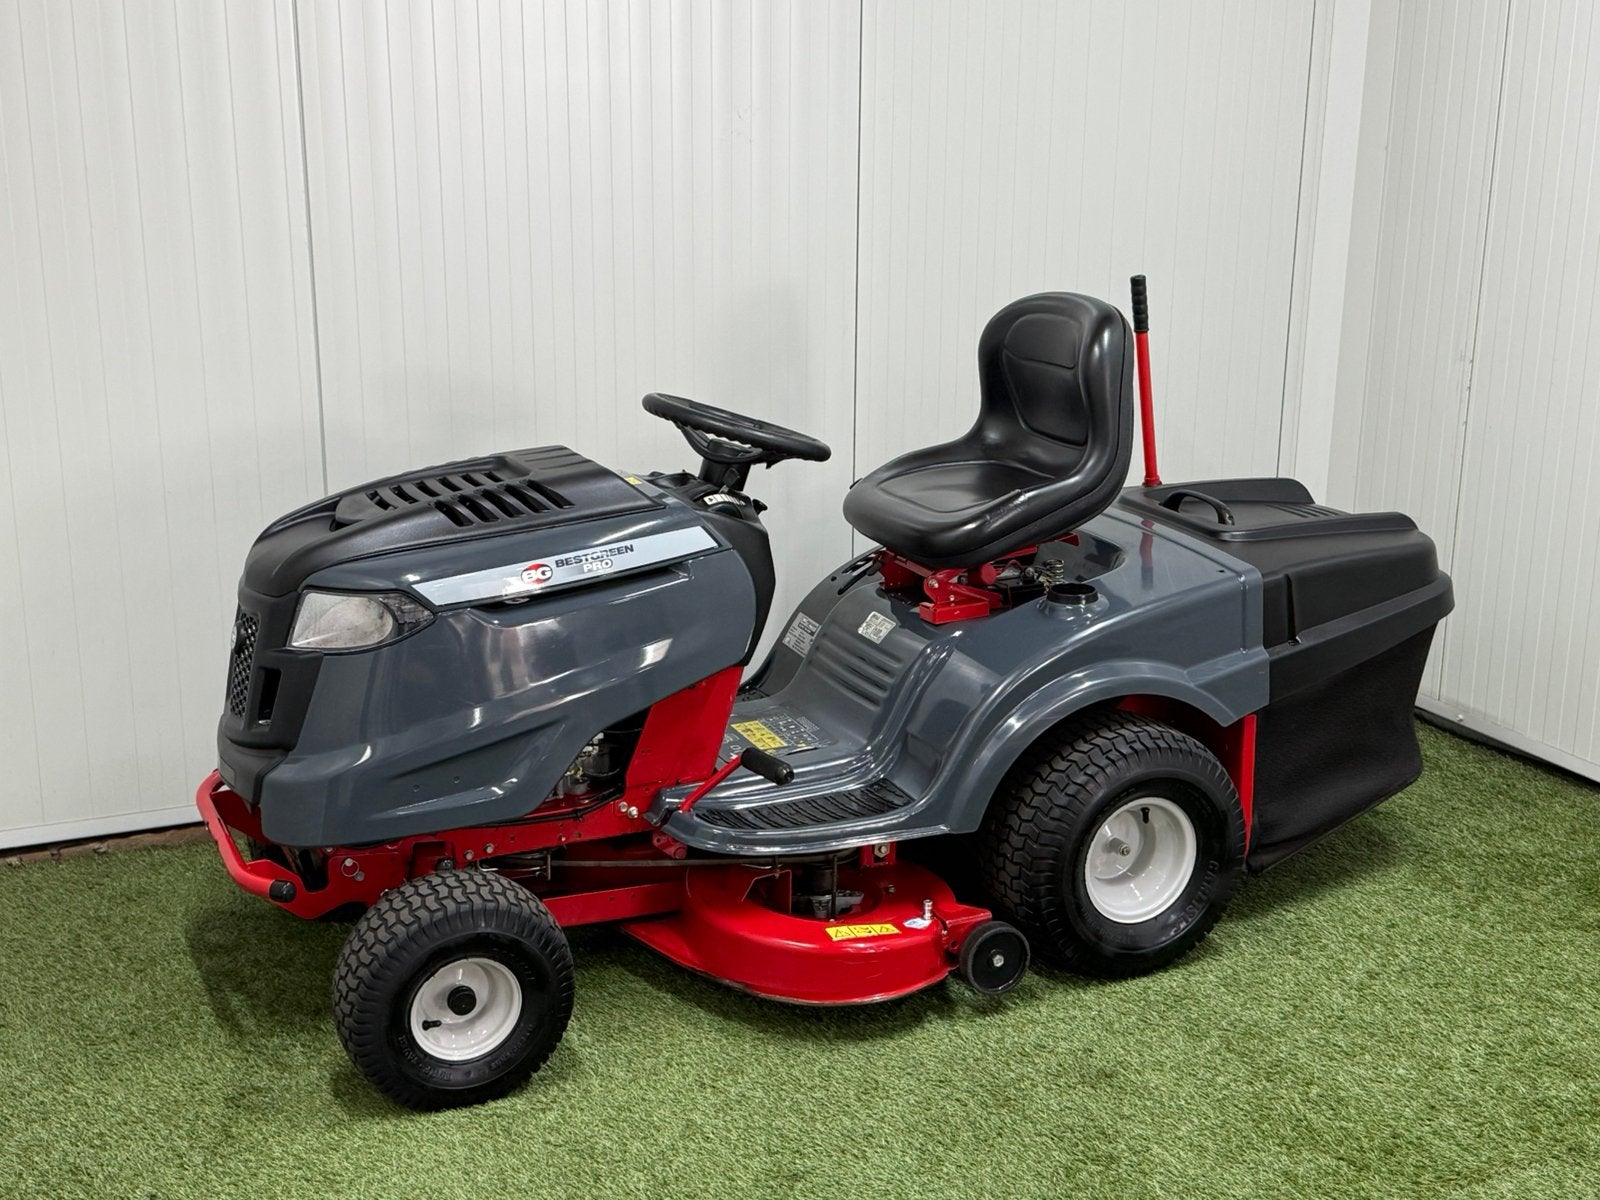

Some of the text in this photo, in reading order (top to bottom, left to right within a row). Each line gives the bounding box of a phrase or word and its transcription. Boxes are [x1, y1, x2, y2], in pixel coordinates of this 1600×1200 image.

[521, 544, 634, 584] BG BESTGREEN
[583, 559, 613, 573] PRO
